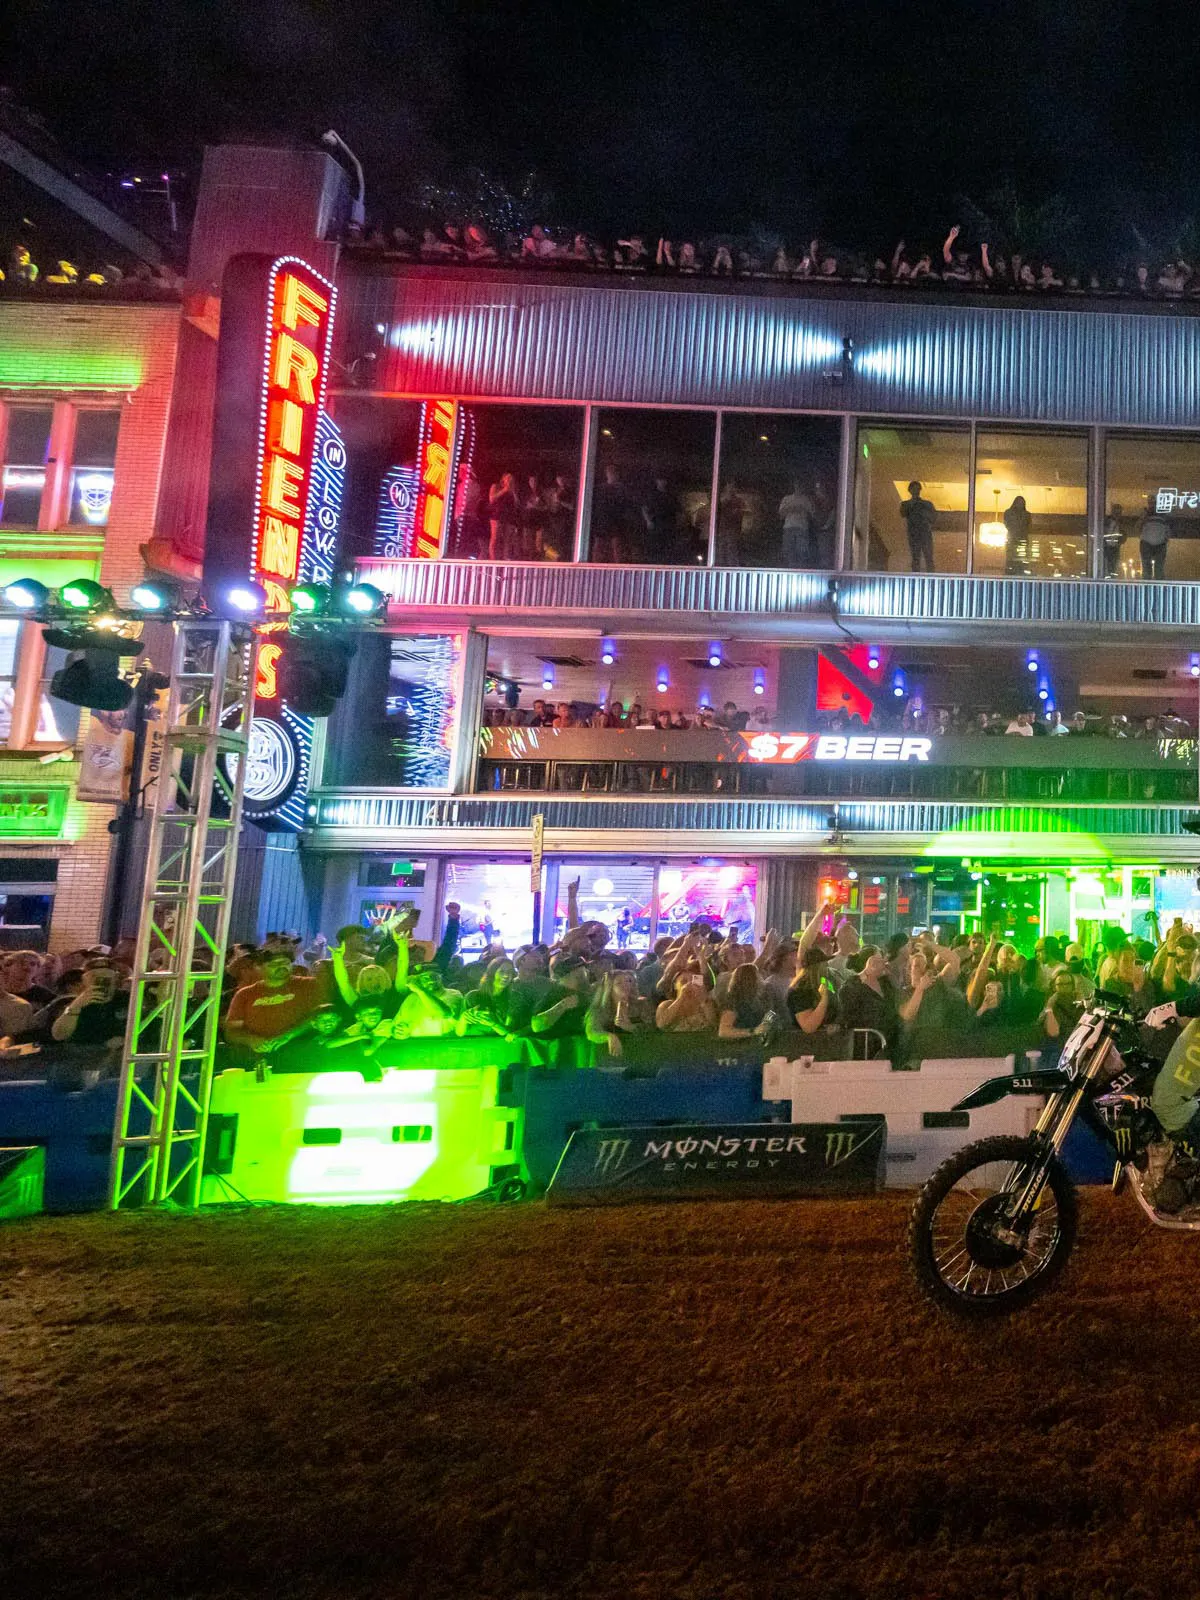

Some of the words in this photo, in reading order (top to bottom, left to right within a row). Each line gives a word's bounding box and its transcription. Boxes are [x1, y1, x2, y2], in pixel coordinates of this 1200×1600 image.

[328, 446, 341, 464] IN
[254, 271, 328, 698] FRIENDS
[747, 733, 809, 761] $7
[814, 736, 932, 761] BEER
[1012, 1078, 1033, 1088] 5.11
[1110, 1073, 1135, 1093] 5.11
[644, 1136, 807, 1159] MONSTER
[663, 1159, 780, 1172] ENERGY
